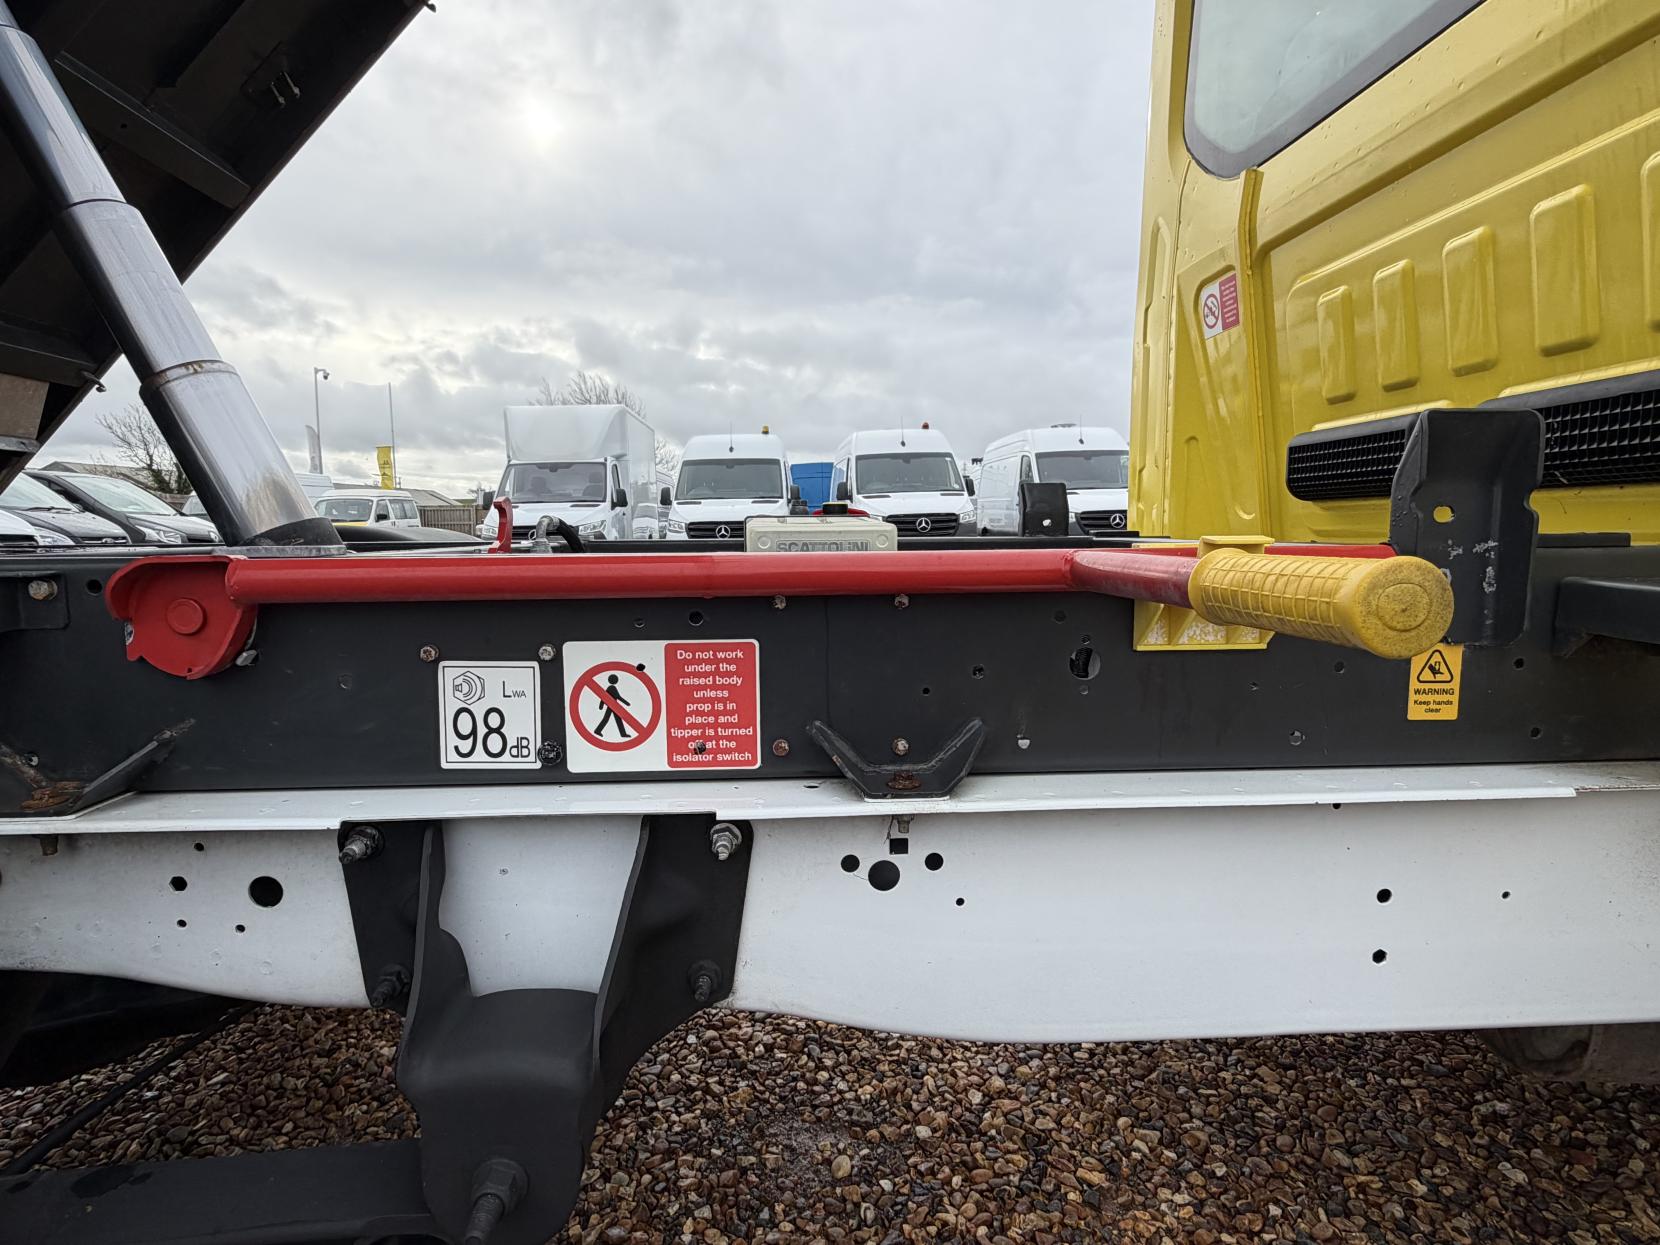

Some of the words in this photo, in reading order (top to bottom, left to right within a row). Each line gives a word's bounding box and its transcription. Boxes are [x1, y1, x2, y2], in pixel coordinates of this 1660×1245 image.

[677, 650, 692, 659] Do
[695, 650, 714, 659] not
[716, 649, 744, 659] work
[684, 663, 716, 672] under
[719, 662, 737, 672] the
[679, 675, 713, 685] raised
[715, 675, 743, 686] body
[693, 688, 729, 698] unless
[686, 703, 712, 712] prop
[714, 701, 724, 710] is
[726, 701, 737, 710] in
[685, 715, 715, 725] place
[717, 714, 738, 723] and
[670, 728, 702, 738] tipper
[705, 727, 715, 736] is
[717, 726, 753, 736] turned
[705, 740, 717, 748] at
[719, 739, 737, 748] the
[672, 753, 714, 762] isolator
[716, 751, 752, 761] switch
